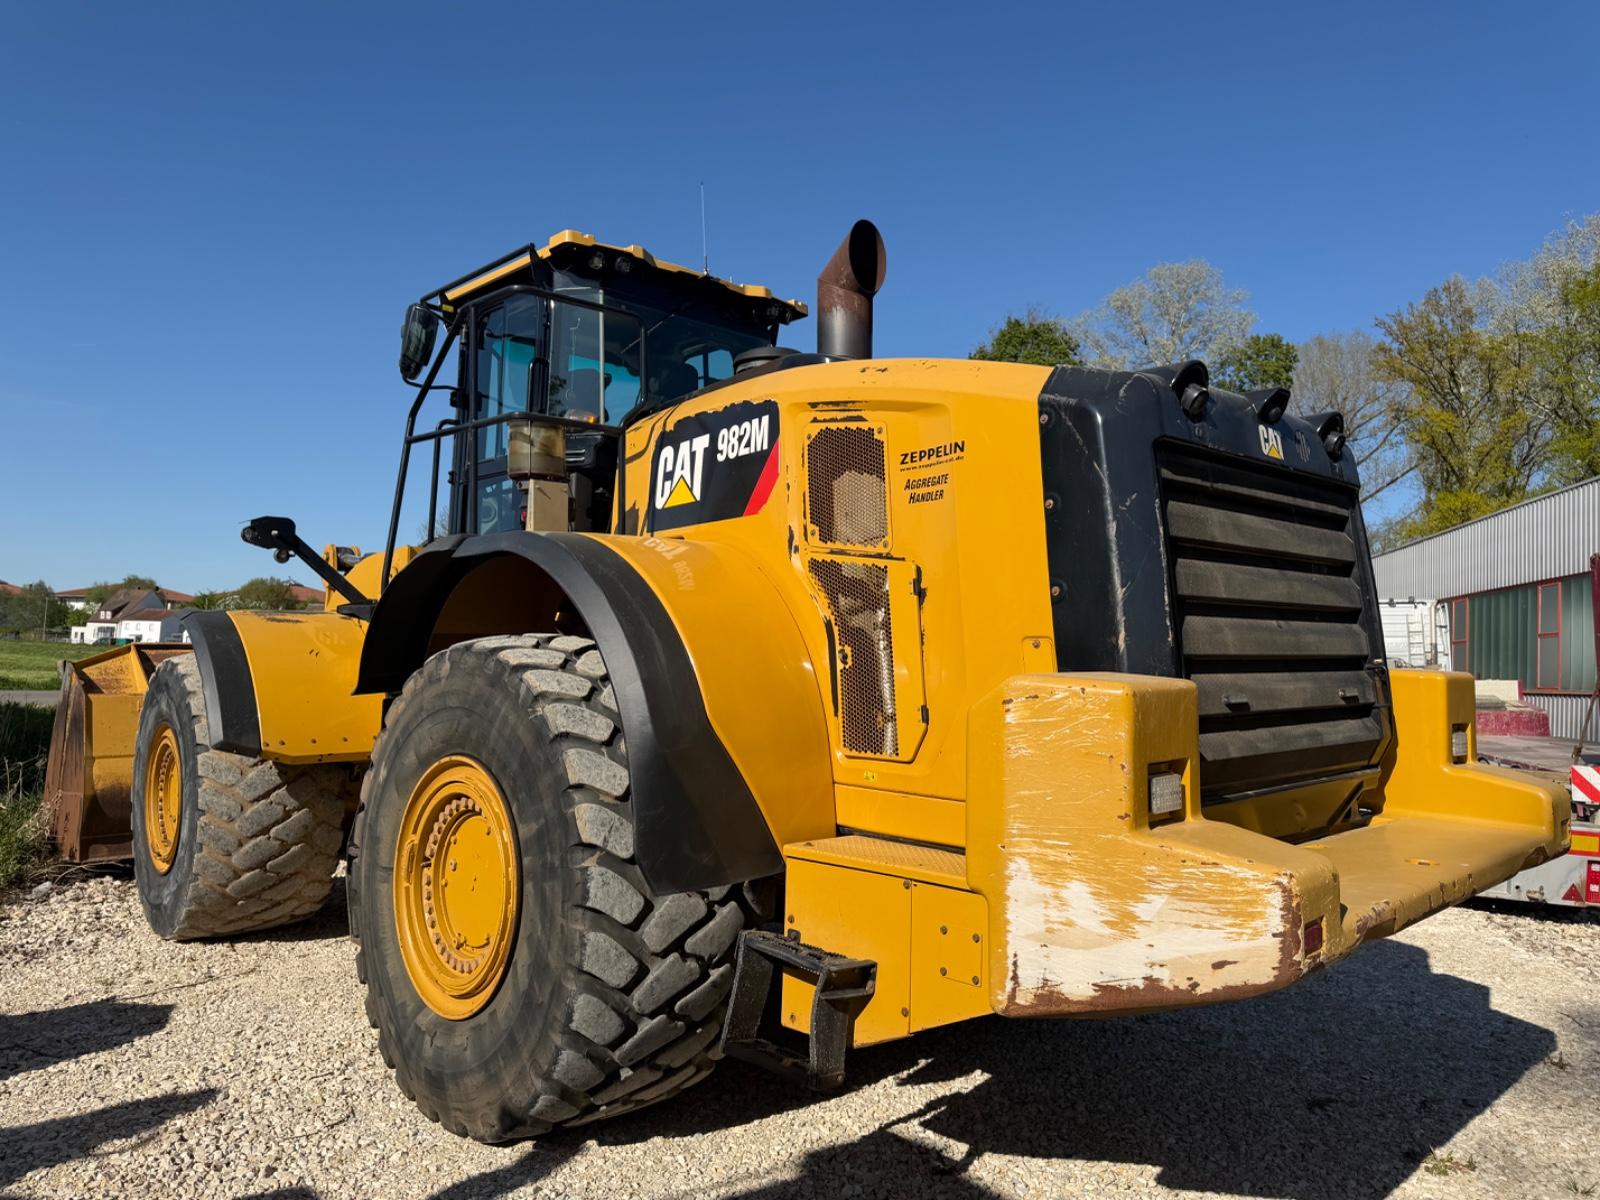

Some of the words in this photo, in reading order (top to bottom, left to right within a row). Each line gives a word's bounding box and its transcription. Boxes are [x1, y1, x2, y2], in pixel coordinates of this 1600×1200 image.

[900, 440, 965, 465] ZEPPELIN
[1258, 424, 1285, 461] CAT
[655, 433, 710, 510] CAT
[716, 414, 770, 462] 982M
[904, 473, 949, 491] AGGREGATE
[908, 489, 944, 504] HANDLER
